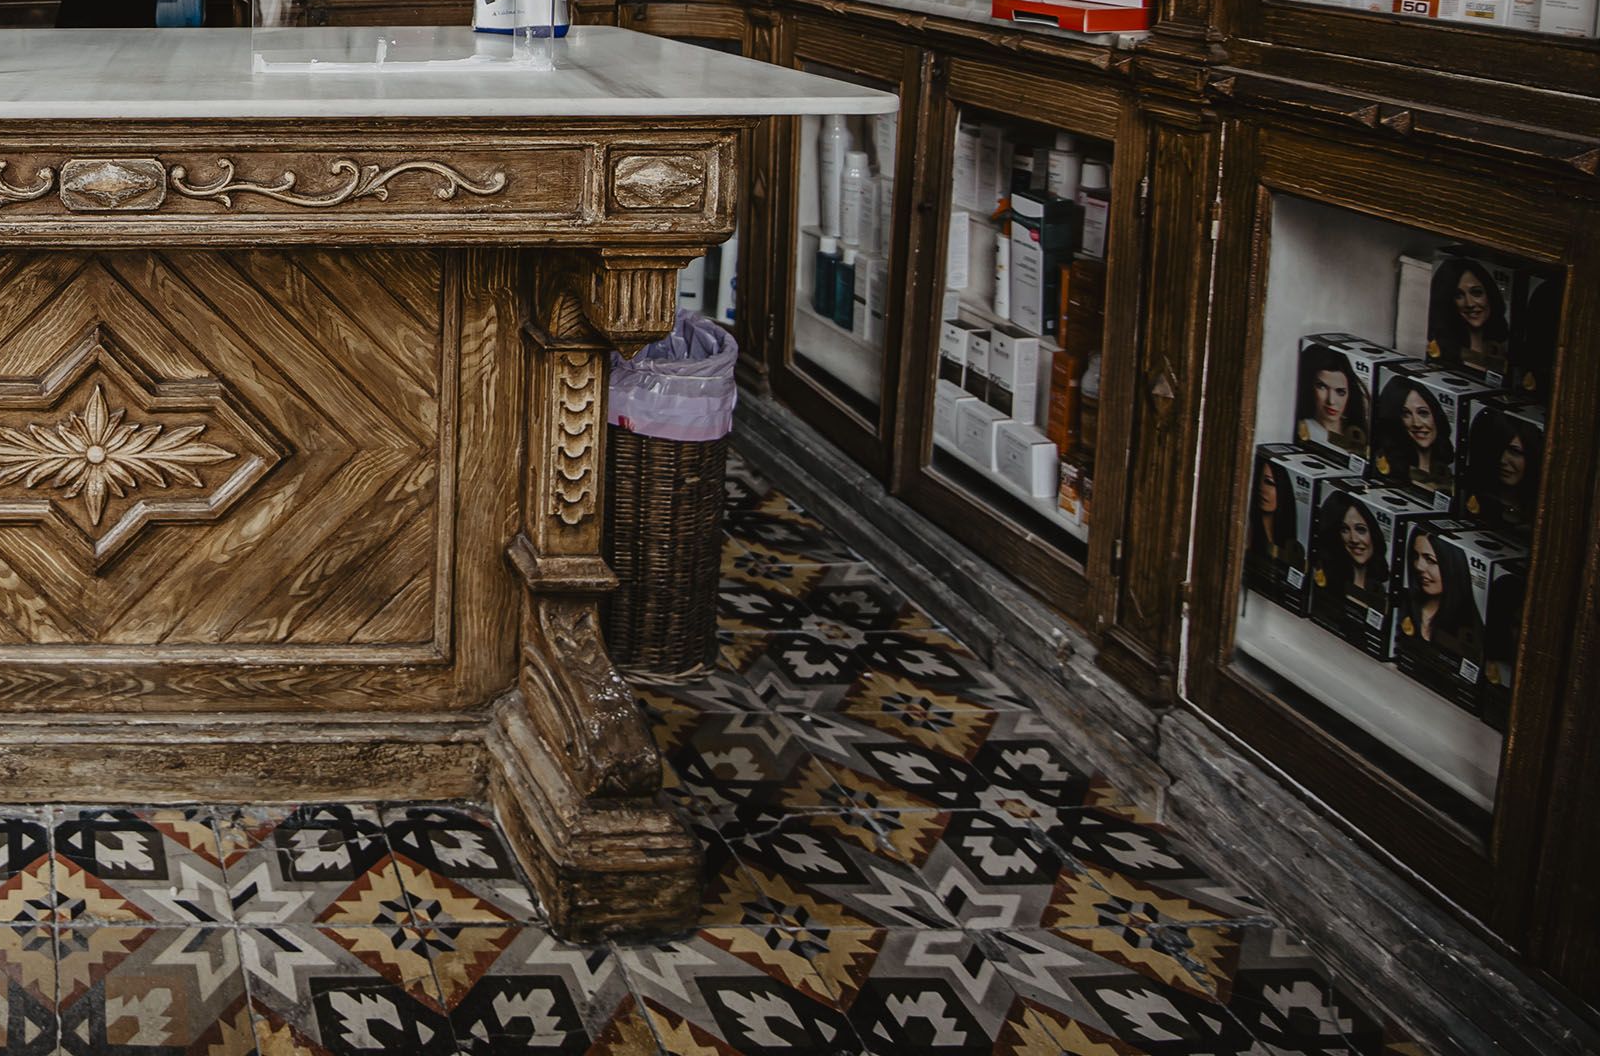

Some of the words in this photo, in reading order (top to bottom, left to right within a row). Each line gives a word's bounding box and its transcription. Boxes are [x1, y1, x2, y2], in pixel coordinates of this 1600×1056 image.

[1402, 0, 1429, 14] 50
[1354, 360, 1370, 374] th
[1438, 392, 1454, 407] th
[1295, 475, 1311, 491] th
[1376, 511, 1391, 526] th
[1470, 556, 1487, 572] th
